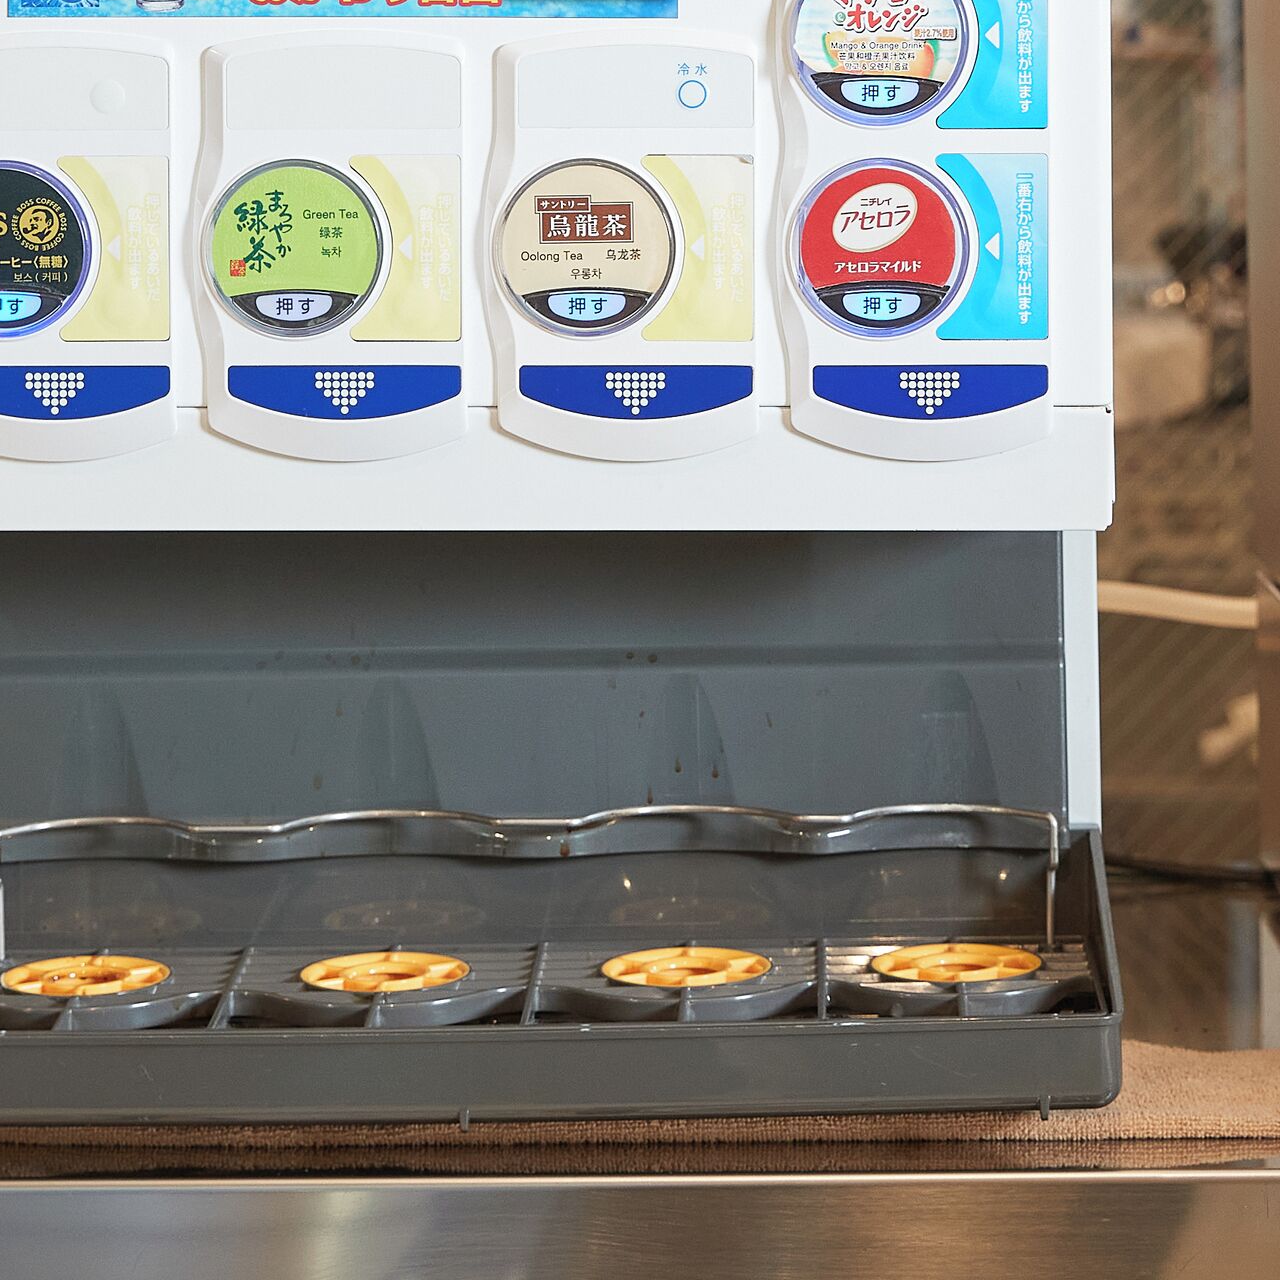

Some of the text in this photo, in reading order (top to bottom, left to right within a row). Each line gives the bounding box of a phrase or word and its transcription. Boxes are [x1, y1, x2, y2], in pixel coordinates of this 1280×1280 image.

[846, 3, 926, 29] オレンジ
[830, 41, 858, 50] Mango
[869, 41, 899, 50] Orange
[901, 41, 923, 49] Drink
[861, 84, 901, 102] 押す
[16, 198, 34, 213] BOSS
[35, 197, 62, 213] COFFEE
[540, 200, 586, 210] サントリー
[860, 197, 893, 207] ニチレイ
[302, 208, 359, 220] Green Tea
[840, 204, 911, 233] アセロラ
[265, 189, 293, 258] まろやか
[547, 214, 627, 238] 烏龍茶
[234, 200, 276, 273] 緑茶
[321, 246, 342, 258] 녹차
[520, 250, 583, 263] Oolong Tea
[605, 248, 641, 261] 乌龙茶
[1016, 172, 1033, 324] 一番右から飲料が出ます
[834, 260, 922, 273] アセロラマイルド
[276, 297, 314, 316] 押す
[569, 297, 607, 315] 押す
[863, 296, 902, 315] 押す
